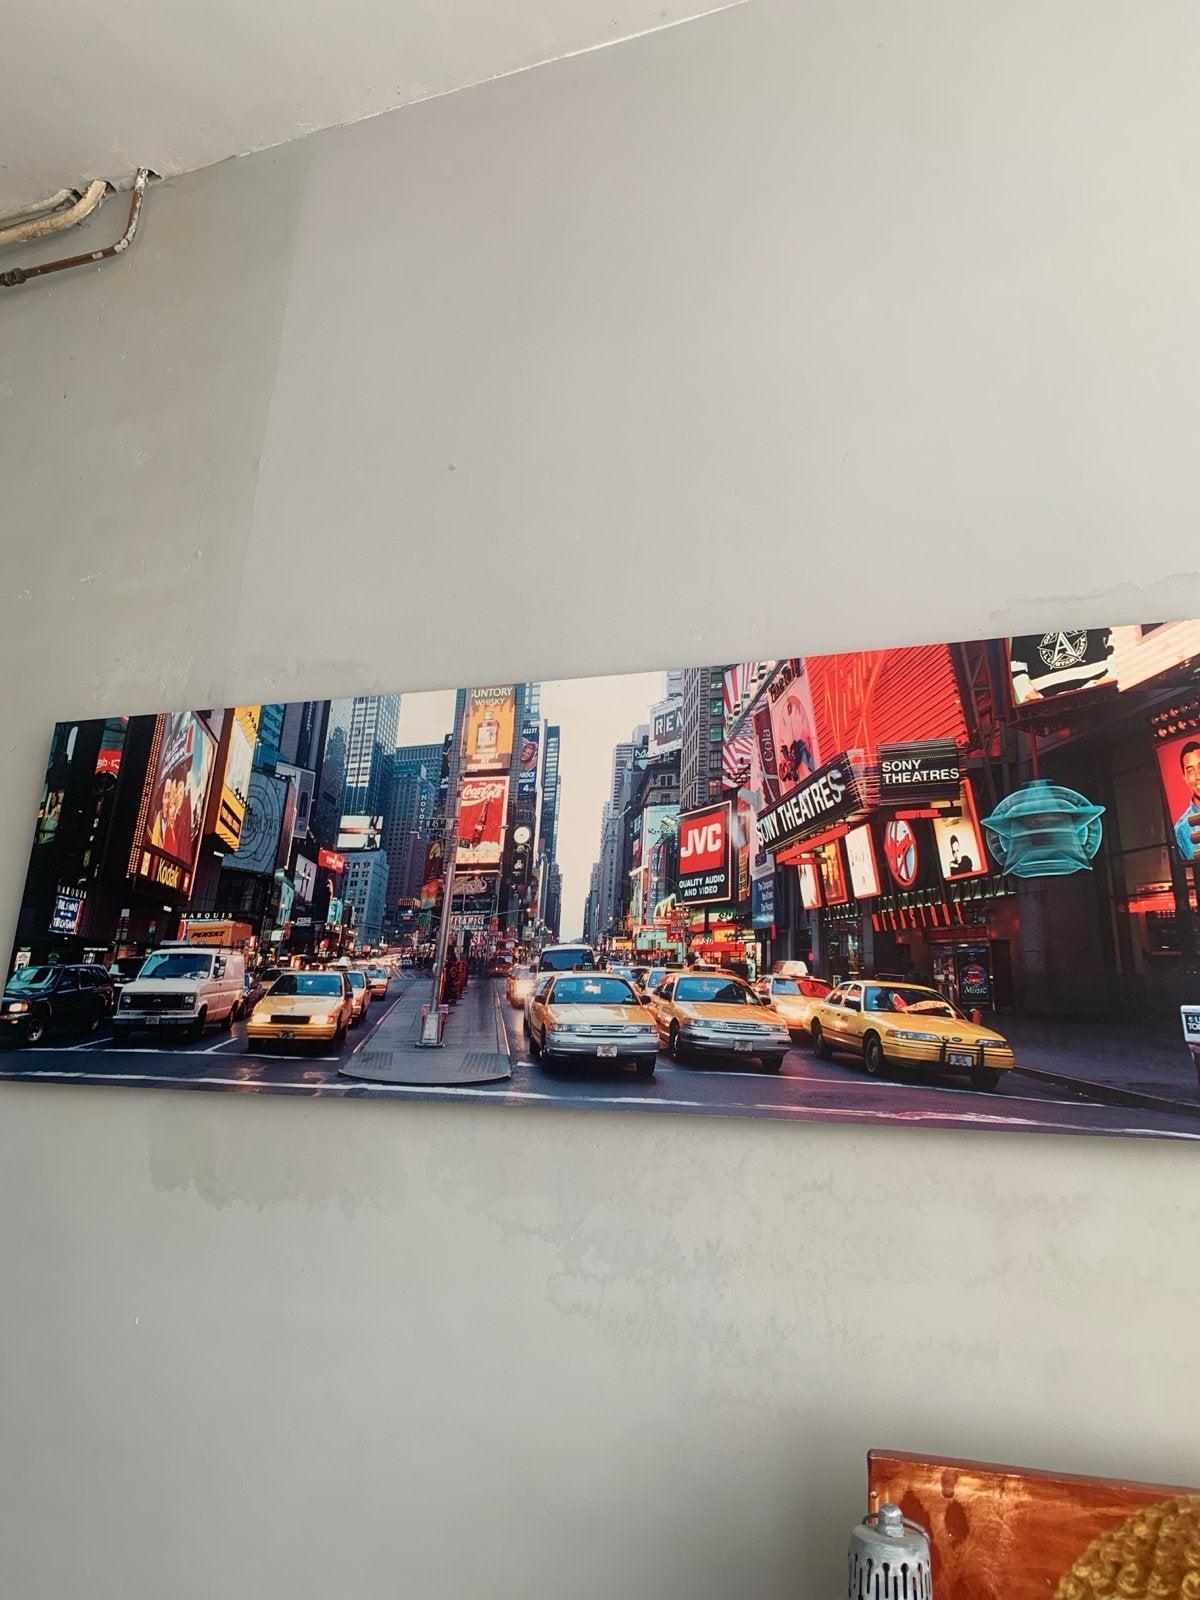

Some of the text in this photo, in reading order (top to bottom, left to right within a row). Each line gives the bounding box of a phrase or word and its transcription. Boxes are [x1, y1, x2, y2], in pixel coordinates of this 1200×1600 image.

[475, 697, 506, 706] WHISKY
[762, 728, 774, 762] Cola
[881, 759, 922, 773] SONY
[882, 768, 960, 784] THEATRES
[462, 782, 505, 800] Coca-Cola
[756, 769, 847, 846] SONY THEATRES
[417, 794, 428, 840] NOVOTEL
[431, 819, 439, 829] 45
[680, 822, 722, 858] JVC
[156, 857, 180, 889] Kodak
[678, 873, 726, 889] QUALITY AUDIO
[684, 885, 718, 897] AND VIDEO
[190, 930, 226, 939] PENSKE
